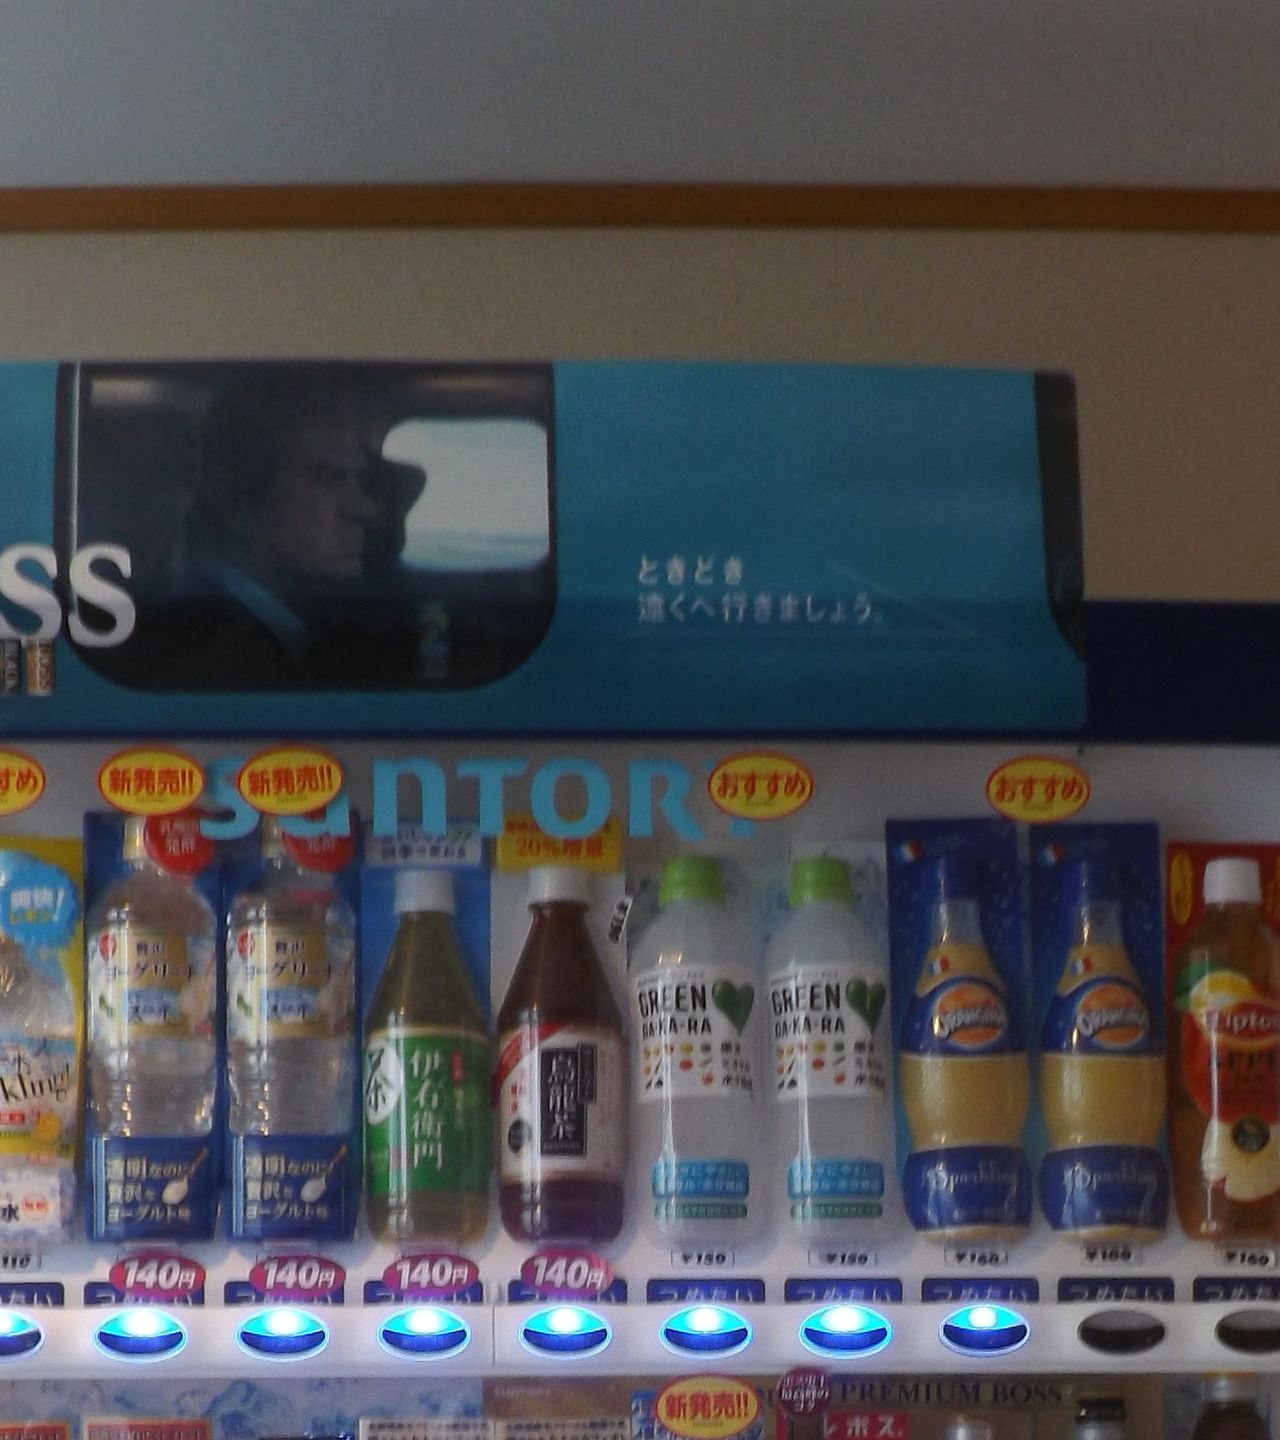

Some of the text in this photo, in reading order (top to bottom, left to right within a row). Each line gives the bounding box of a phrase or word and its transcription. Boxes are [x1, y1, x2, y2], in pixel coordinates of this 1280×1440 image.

[638, 554, 745, 585] ときどき
[107, 766, 195, 796] 新発売!!
[247, 765, 333, 796] 新発売!!
[717, 769, 807, 799] おすすめ
[993, 774, 1083, 802] おすすめ
[637, 983, 708, 1019] GREEN
[771, 983, 842, 1019] GREEN
[547, 1051, 576, 1140] 烏龍茶
[123, 1258, 195, 1290] 140円
[264, 1258, 335, 1290] 140円
[397, 1256, 468, 1288] 140円
[533, 1257, 605, 1290] 140円
[665, 1393, 751, 1419] 新発売!!
[840, 1382, 1064, 1404] PREMIUM BOSS
